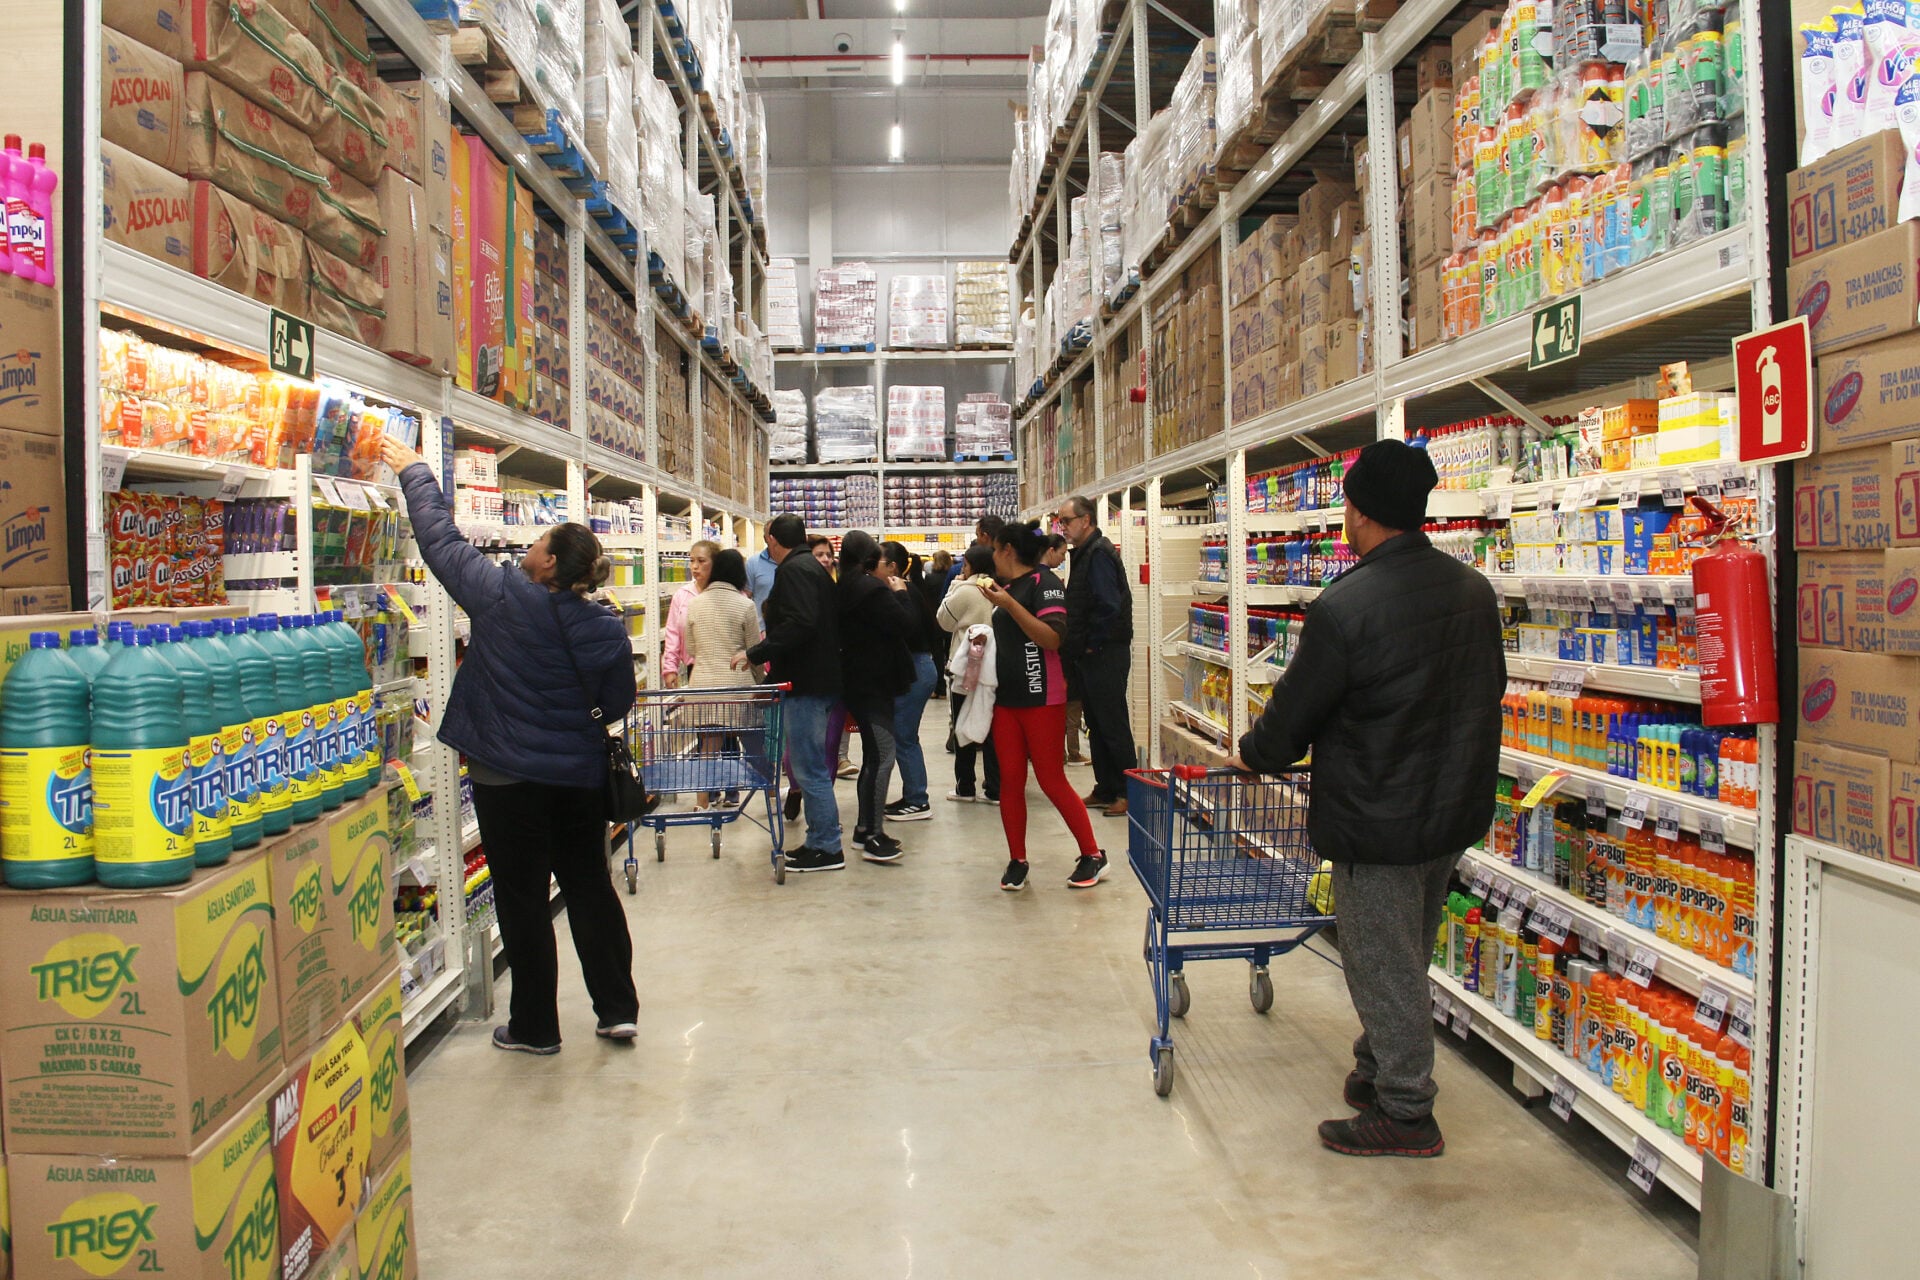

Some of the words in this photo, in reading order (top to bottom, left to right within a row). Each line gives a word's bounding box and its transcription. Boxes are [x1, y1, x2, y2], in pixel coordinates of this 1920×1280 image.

[110, 77, 171, 108] ASSOLAN
[1846, 160, 1874, 178] REMOVE
[126, 197, 190, 234] ASSOLAN
[1841, 205, 1885, 243] T-434-P4
[1485, 268, 1496, 281] BP
[1846, 277, 1862, 293] TIRA
[1864, 263, 1902, 290] MANCHAS
[1860, 290, 1871, 305] DO
[1873, 278, 1903, 300] MUNDO
[1880, 372, 1897, 388] TIRA
[1900, 366, 1920, 385] MAN
[1764, 394, 1780, 407] ABC
[1896, 385, 1908, 401] DO
[1852, 475, 1880, 485] REMOVE
[1852, 509, 1880, 519] ROUPAS
[6, 517, 45, 553] Limpol
[1844, 523, 1890, 547] T-434-P4
[1025, 641, 1042, 693] GINÁSTICA
[1851, 691, 1866, 705] TIRA
[1868, 692, 1907, 711] MANCHAS
[1865, 709, 1876, 722] DO
[1877, 711, 1906, 727] MUNDO
[339, 725, 362, 757] TR
[286, 738, 314, 775] TR
[226, 754, 257, 796] TR
[192, 766, 225, 810] TR
[290, 783, 302, 794] 2L
[55, 783, 92, 825] TR
[158, 782, 192, 826] TR
[230, 805, 243, 817] 2L
[198, 820, 211, 833] 2L
[63, 836, 77, 849] 2L
[165, 837, 178, 851] 2L
[1840, 825, 1885, 859] T-434-P4
[1636, 876, 1650, 892] BP
[1680, 887, 1693, 902] BP
[207, 897, 225, 923] ÁGUA
[225, 877, 256, 912] SANITÁRIA
[30, 904, 66, 922] ÁGUA
[70, 906, 138, 924] SANITÁRIA
[1734, 914, 1748, 931] BP
[1537, 982, 1550, 996] BP
[120, 991, 146, 1015] 2L
[55, 1028, 70, 1041] CX
[110, 1029, 123, 1043] 2L
[44, 1043, 136, 1059] EMPILHAMENTO
[90, 1058, 97, 1072] 5
[101, 1058, 142, 1075] CAIXAS
[1700, 1083, 1714, 1102] BP
[192, 1097, 208, 1135] 2L
[273, 1078, 299, 1147] MAX
[311, 1109, 333, 1136] VAREJO
[223, 1146, 242, 1172] ÁGUA
[47, 1165, 84, 1182] ÁGUA
[87, 1164, 157, 1183] SANITÁRIA
[138, 1249, 164, 1272] 2L
